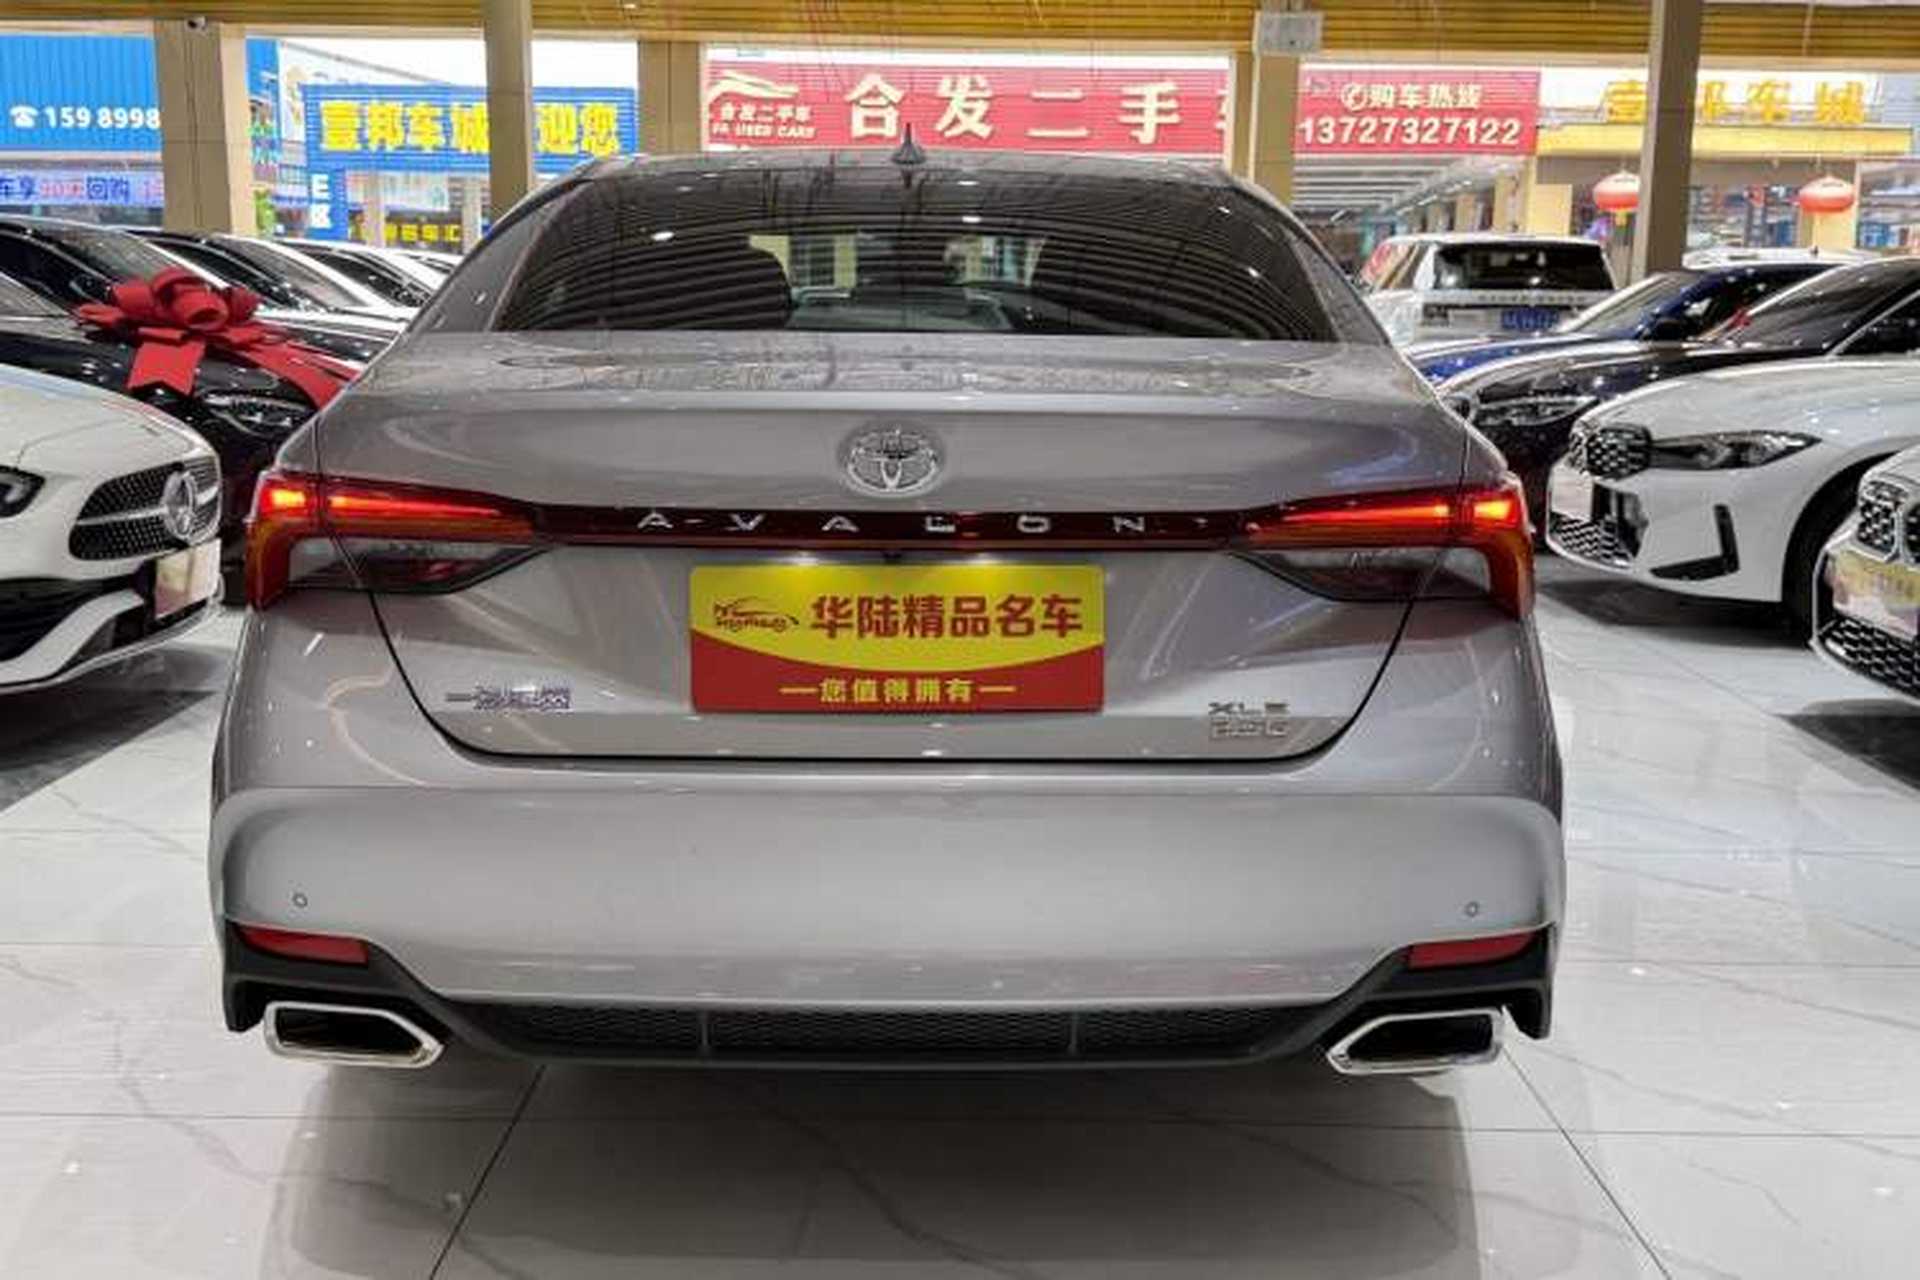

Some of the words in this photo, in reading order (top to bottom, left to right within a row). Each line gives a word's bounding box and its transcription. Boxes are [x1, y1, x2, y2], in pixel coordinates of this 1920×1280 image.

[43, 105, 91, 128] 159
[97, 106, 160, 129] 8998
[845, 72, 1230, 146] 合发二手
[1296, 115, 1521, 145] 13727327122
[636, 512, 1146, 533] AVALON
[811, 593, 1083, 638] 华陆精品名车
[819, 678, 974, 703] 您值得拥有
